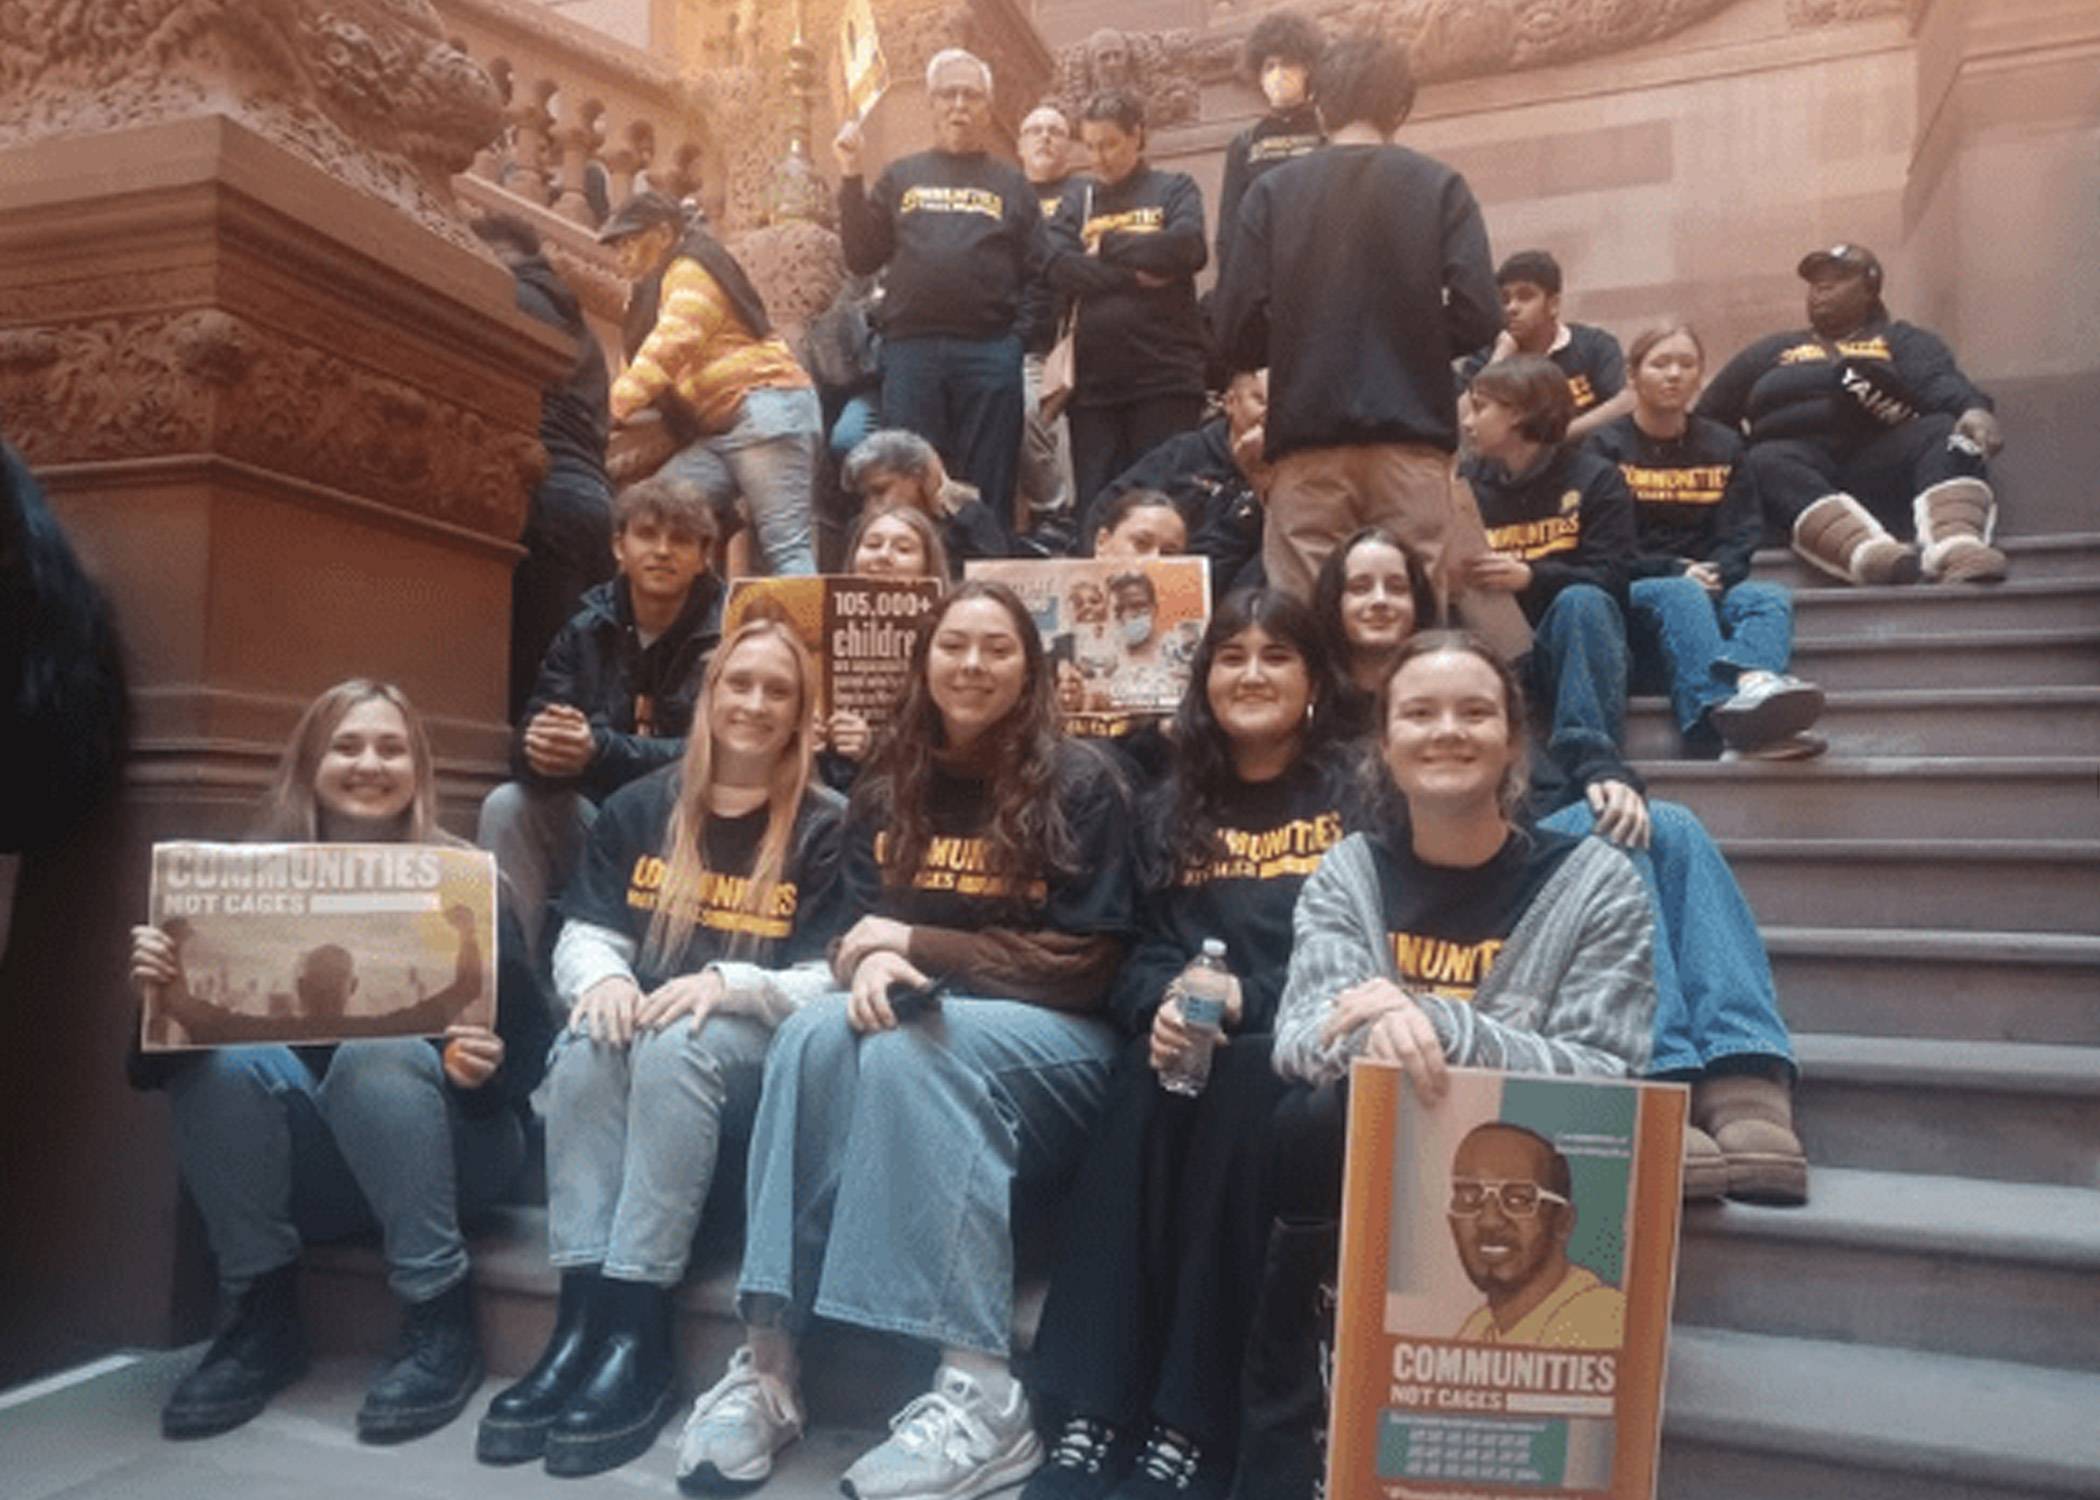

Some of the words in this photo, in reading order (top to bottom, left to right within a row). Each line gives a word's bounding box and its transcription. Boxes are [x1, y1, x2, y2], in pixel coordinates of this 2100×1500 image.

[166, 849, 441, 889] COMMUNITIES
[162, 893, 222, 914] NOT
[223, 892, 307, 914] CAGES
[1392, 1341, 1617, 1393] COMMUNITIES
[1389, 1383, 1435, 1406] NOT
[1437, 1387, 1502, 1411] CAGES
